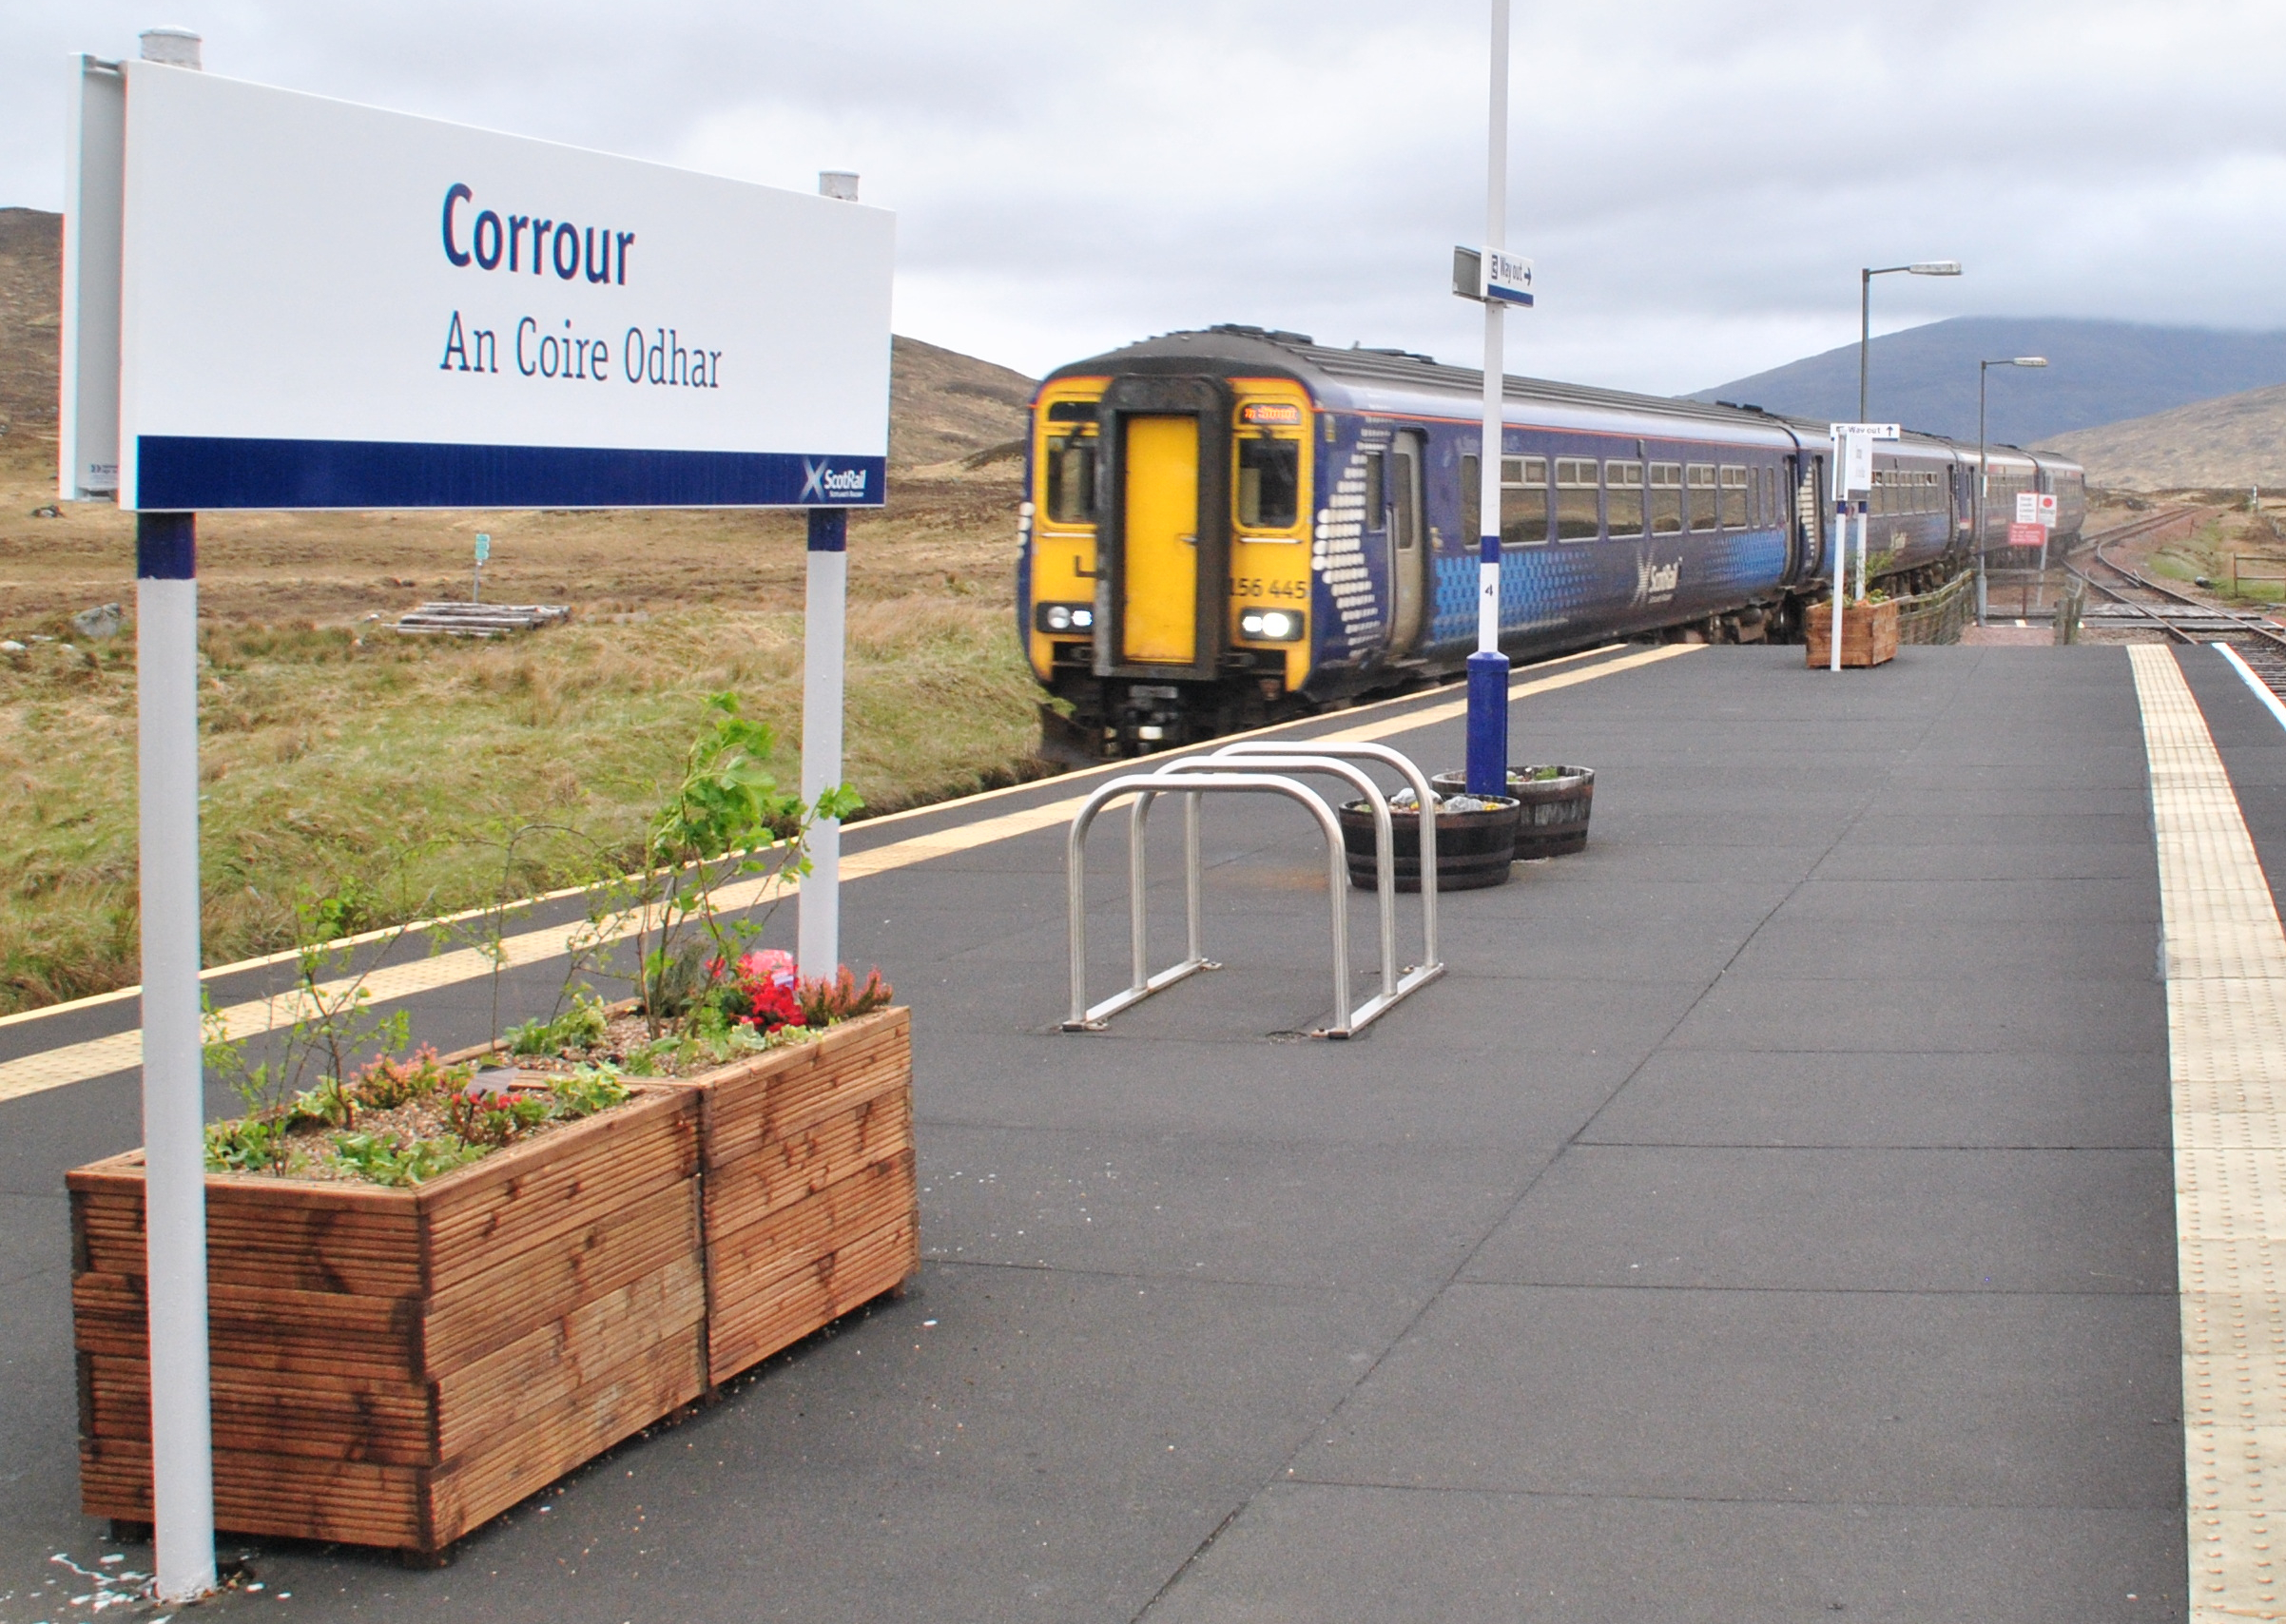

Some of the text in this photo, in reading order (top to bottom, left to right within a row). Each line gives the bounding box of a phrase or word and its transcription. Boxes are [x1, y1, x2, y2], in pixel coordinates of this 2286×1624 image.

[442, 183, 635, 286] Corrour
[1500, 256, 1522, 284] Way out
[439, 310, 722, 388] An Coire Odhar
[1848, 426, 1865, 435] Way
[823, 469, 867, 490] ScotRail
[1269, 580, 1307, 600] 445
[1484, 583, 1494, 597] 4
